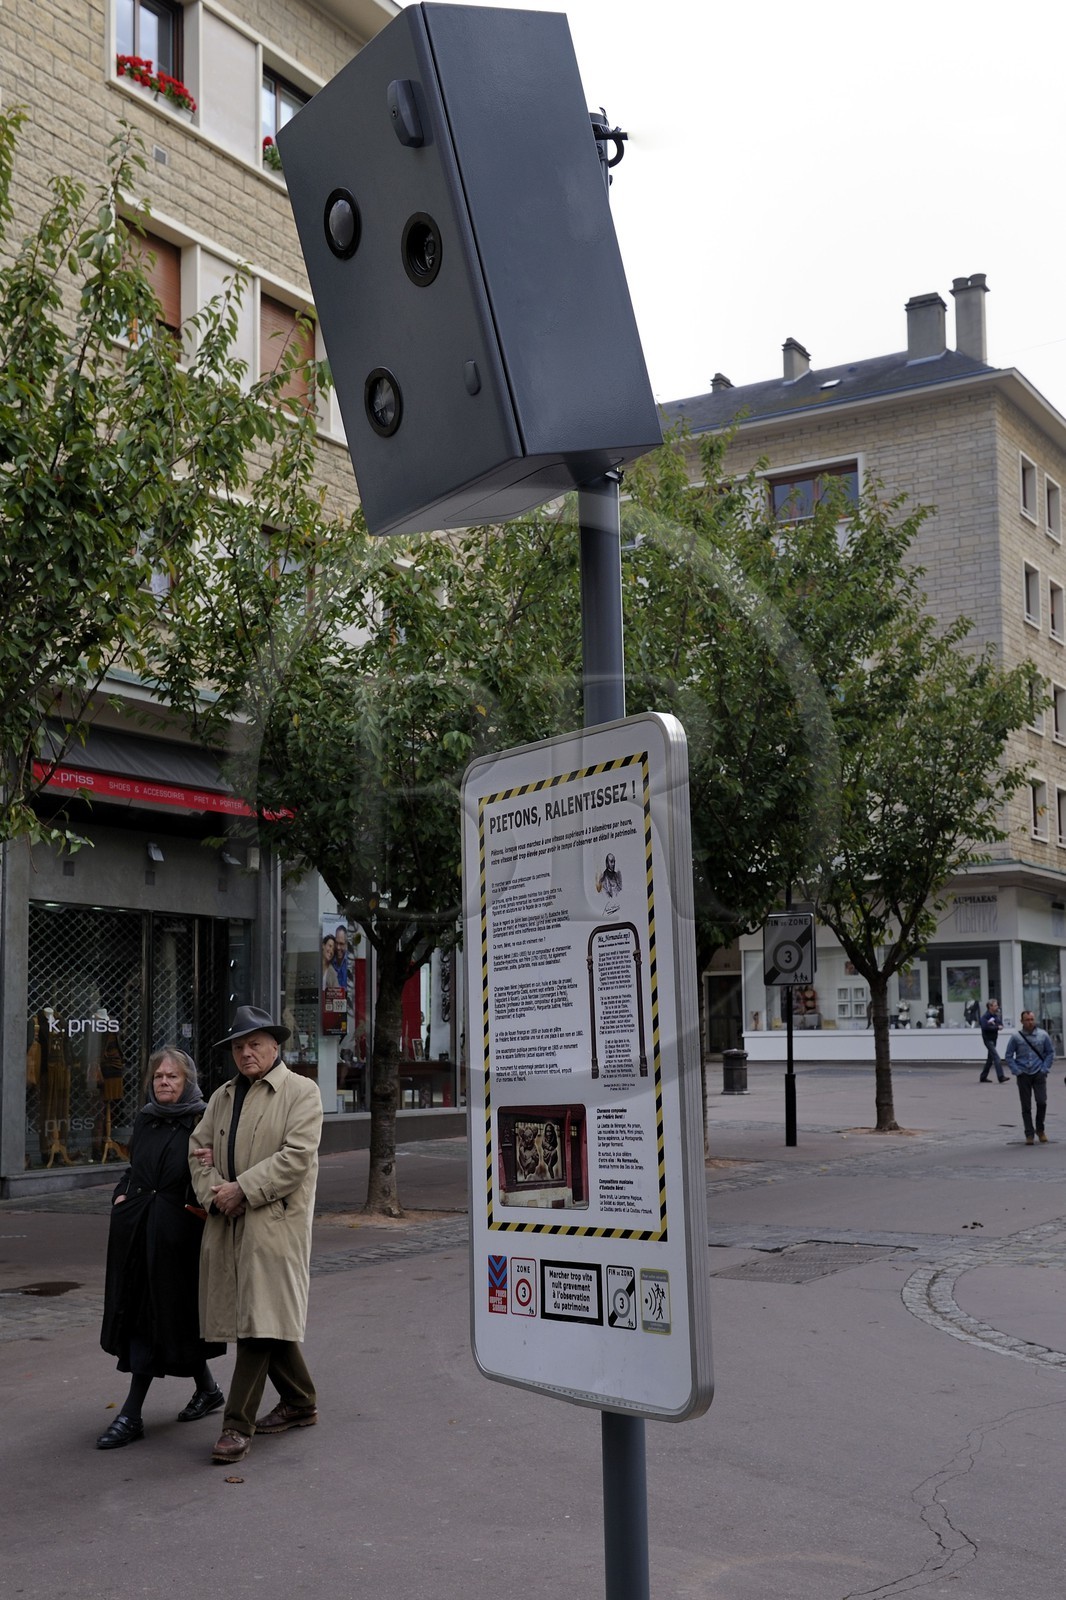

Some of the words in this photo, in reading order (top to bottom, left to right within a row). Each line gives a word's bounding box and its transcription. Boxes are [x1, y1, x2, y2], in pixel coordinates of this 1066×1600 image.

[109, 782, 130, 791] SHOES
[143, 788, 184, 800] ACCESSOIRES
[220, 800, 241, 809] PORTER
[490, 807, 541, 834] PIETONS,
[546, 783, 627, 820] RALENTISSEZ
[632, 780, 636, 799] !
[565, 830, 584, 839] supérieure
[592, 824, 612, 833] kilomètres
[573, 838, 592, 847] d'observer
[599, 833, 609, 841] détail
[784, 950, 792, 963] 3
[48, 1015, 120, 1037] k.priss
[516, 1265, 530, 1273] ZONE
[549, 1270, 569, 1280] Marcher
[570, 1272, 582, 1282] trop
[583, 1273, 592, 1282] vite
[522, 1287, 527, 1298] 3
[563, 1283, 590, 1292] gravement
[552, 1291, 556, 1299] à
[557, 1291, 590, 1302] l'observation
[561, 1303, 589, 1312] patrimoine
[619, 1298, 624, 1309] 3
